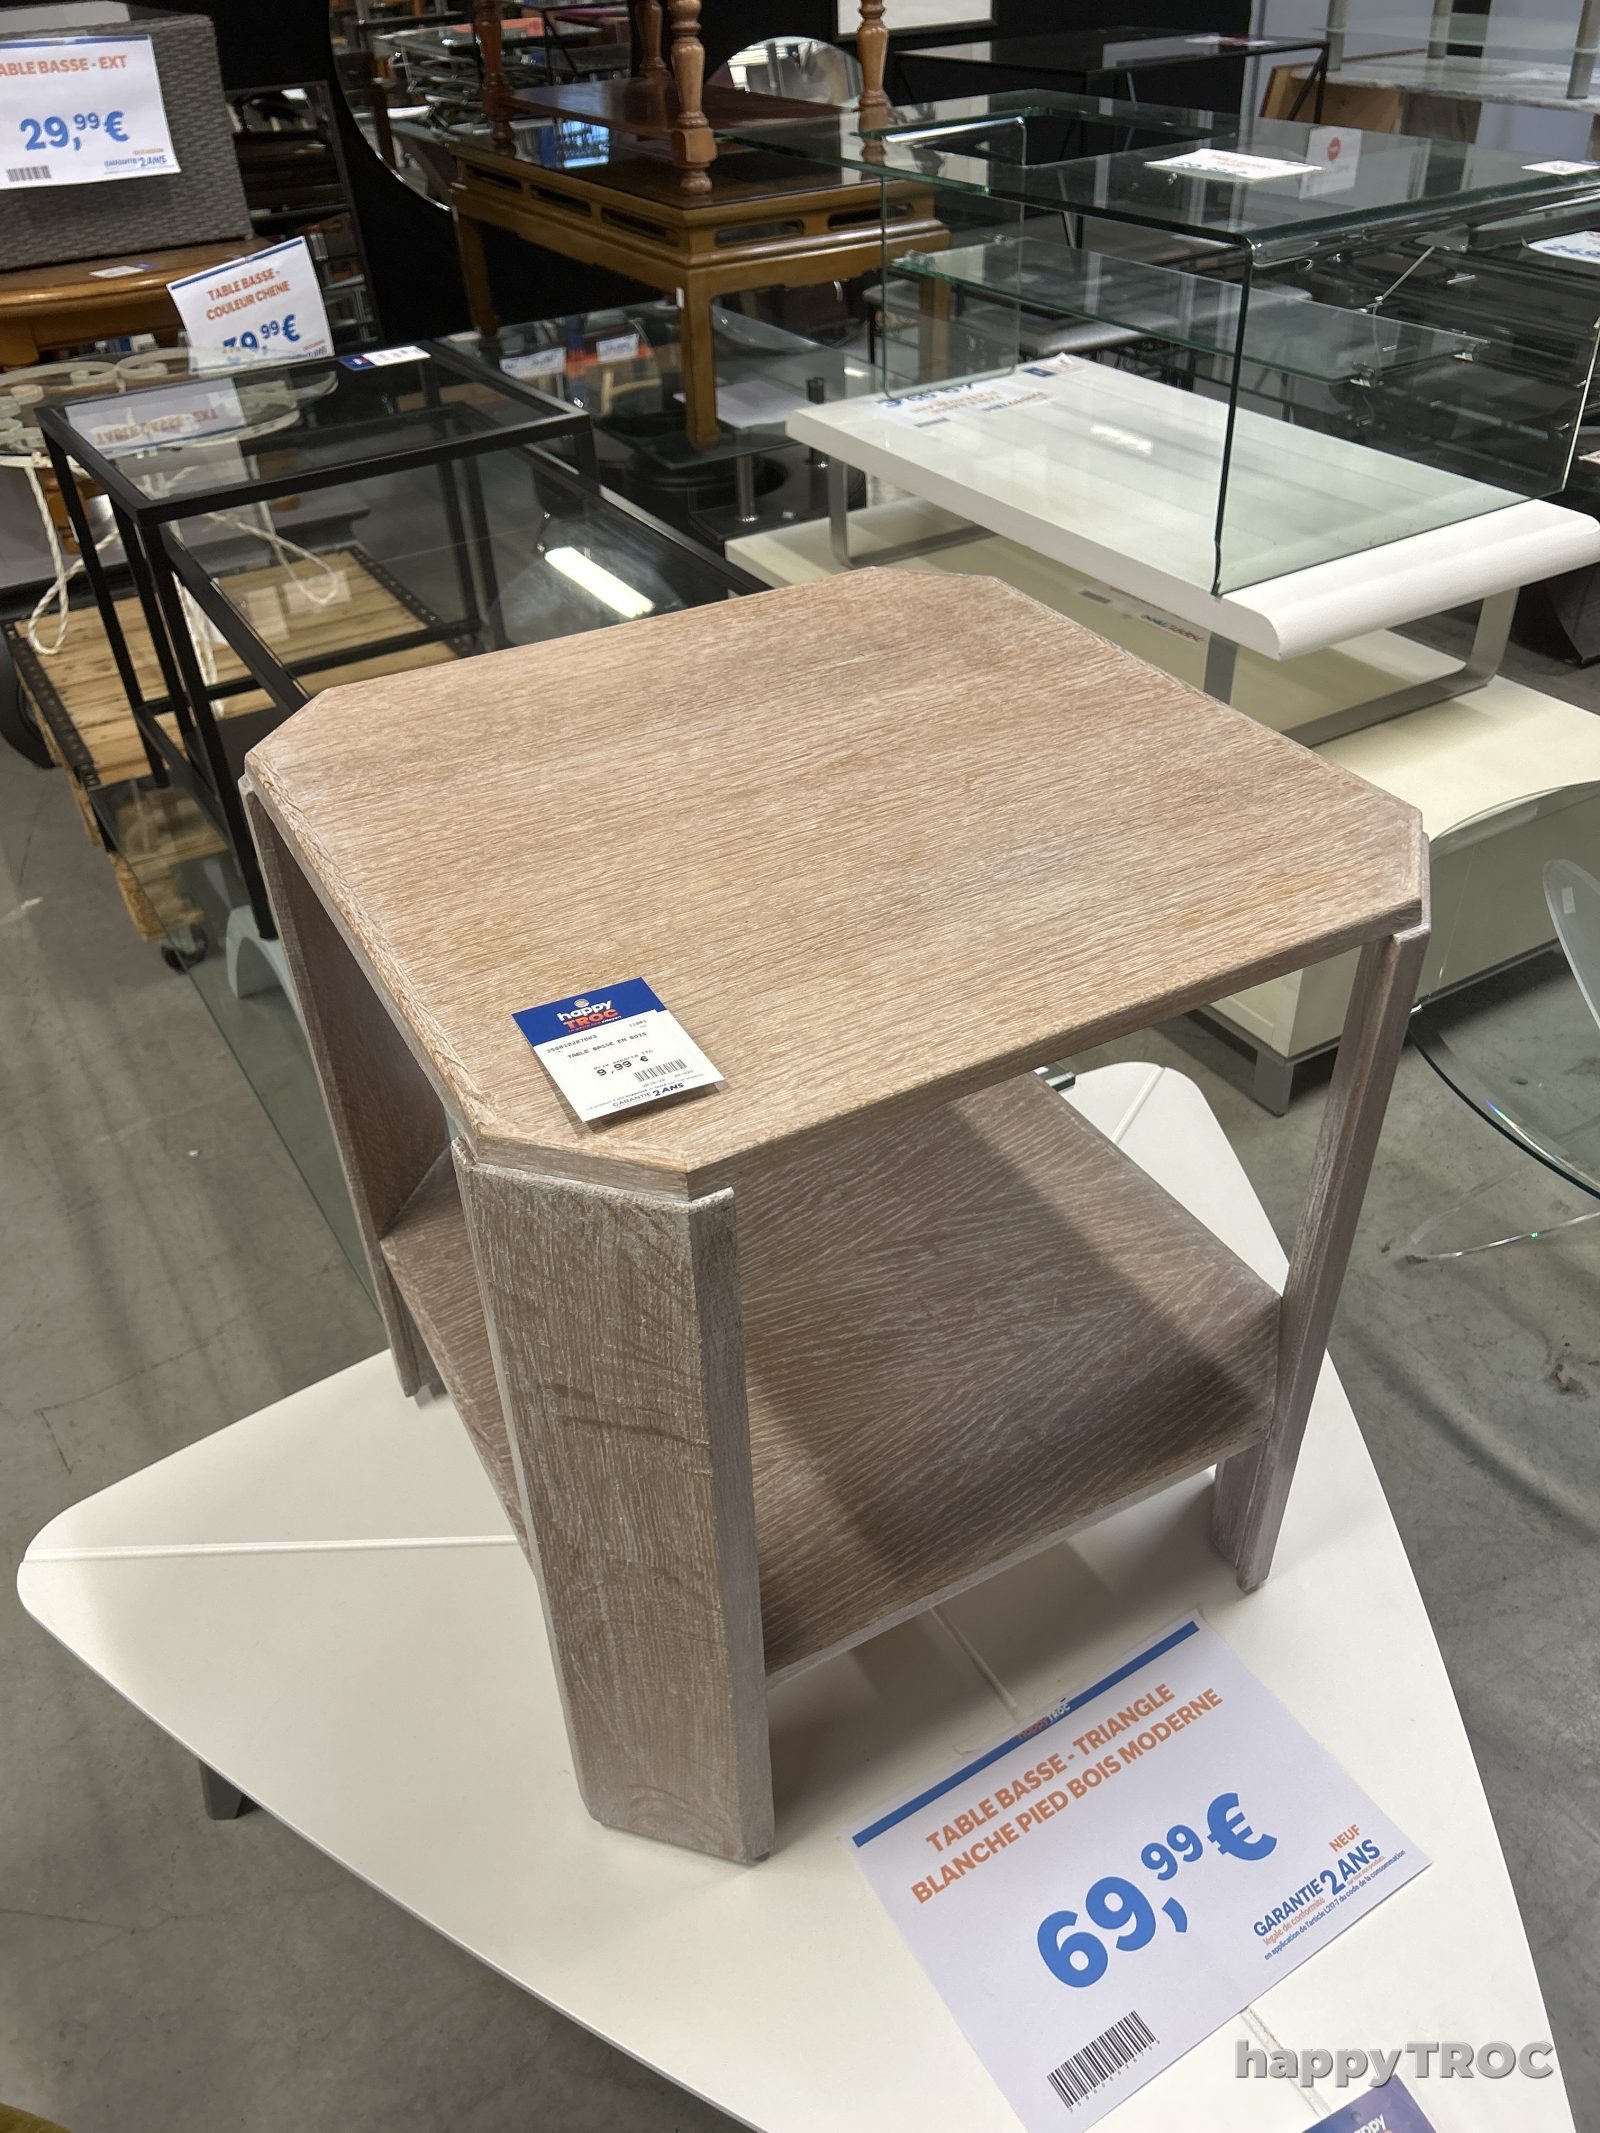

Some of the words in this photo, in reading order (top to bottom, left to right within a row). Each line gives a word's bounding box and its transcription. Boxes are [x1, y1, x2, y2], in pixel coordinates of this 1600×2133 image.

[0, 60, 35, 77] ABLE
[39, 58, 89, 74] BASSE
[98, 55, 128, 70] EXT
[207, 280, 242, 301] TABLE
[242, 267, 275, 289] BASSE
[206, 294, 257, 321] COULEUR
[556, 999, 612, 1022] happy
[563, 1009, 619, 1031] TROC
[568, 1049, 589, 1059] TABLE
[924, 1799, 997, 1854] TABLE
[995, 1755, 1066, 1810] BASSE
[1072, 1683, 1176, 1758] TRIANGLE
[910, 1823, 1020, 1904] BLANCHE
[1018, 1790, 1071, 1836] PIED
[1066, 1756, 1122, 1801] BOIS
[1117, 1687, 1224, 1765] MODERNE
[1328, 1823, 1361, 1852] NEUF
[1253, 1878, 1324, 1937] GARANTIE
[1272, 1930, 1301, 1956] application
[1345, 1884, 1360, 1898] code
[1370, 1849, 1406, 1879] consommation
